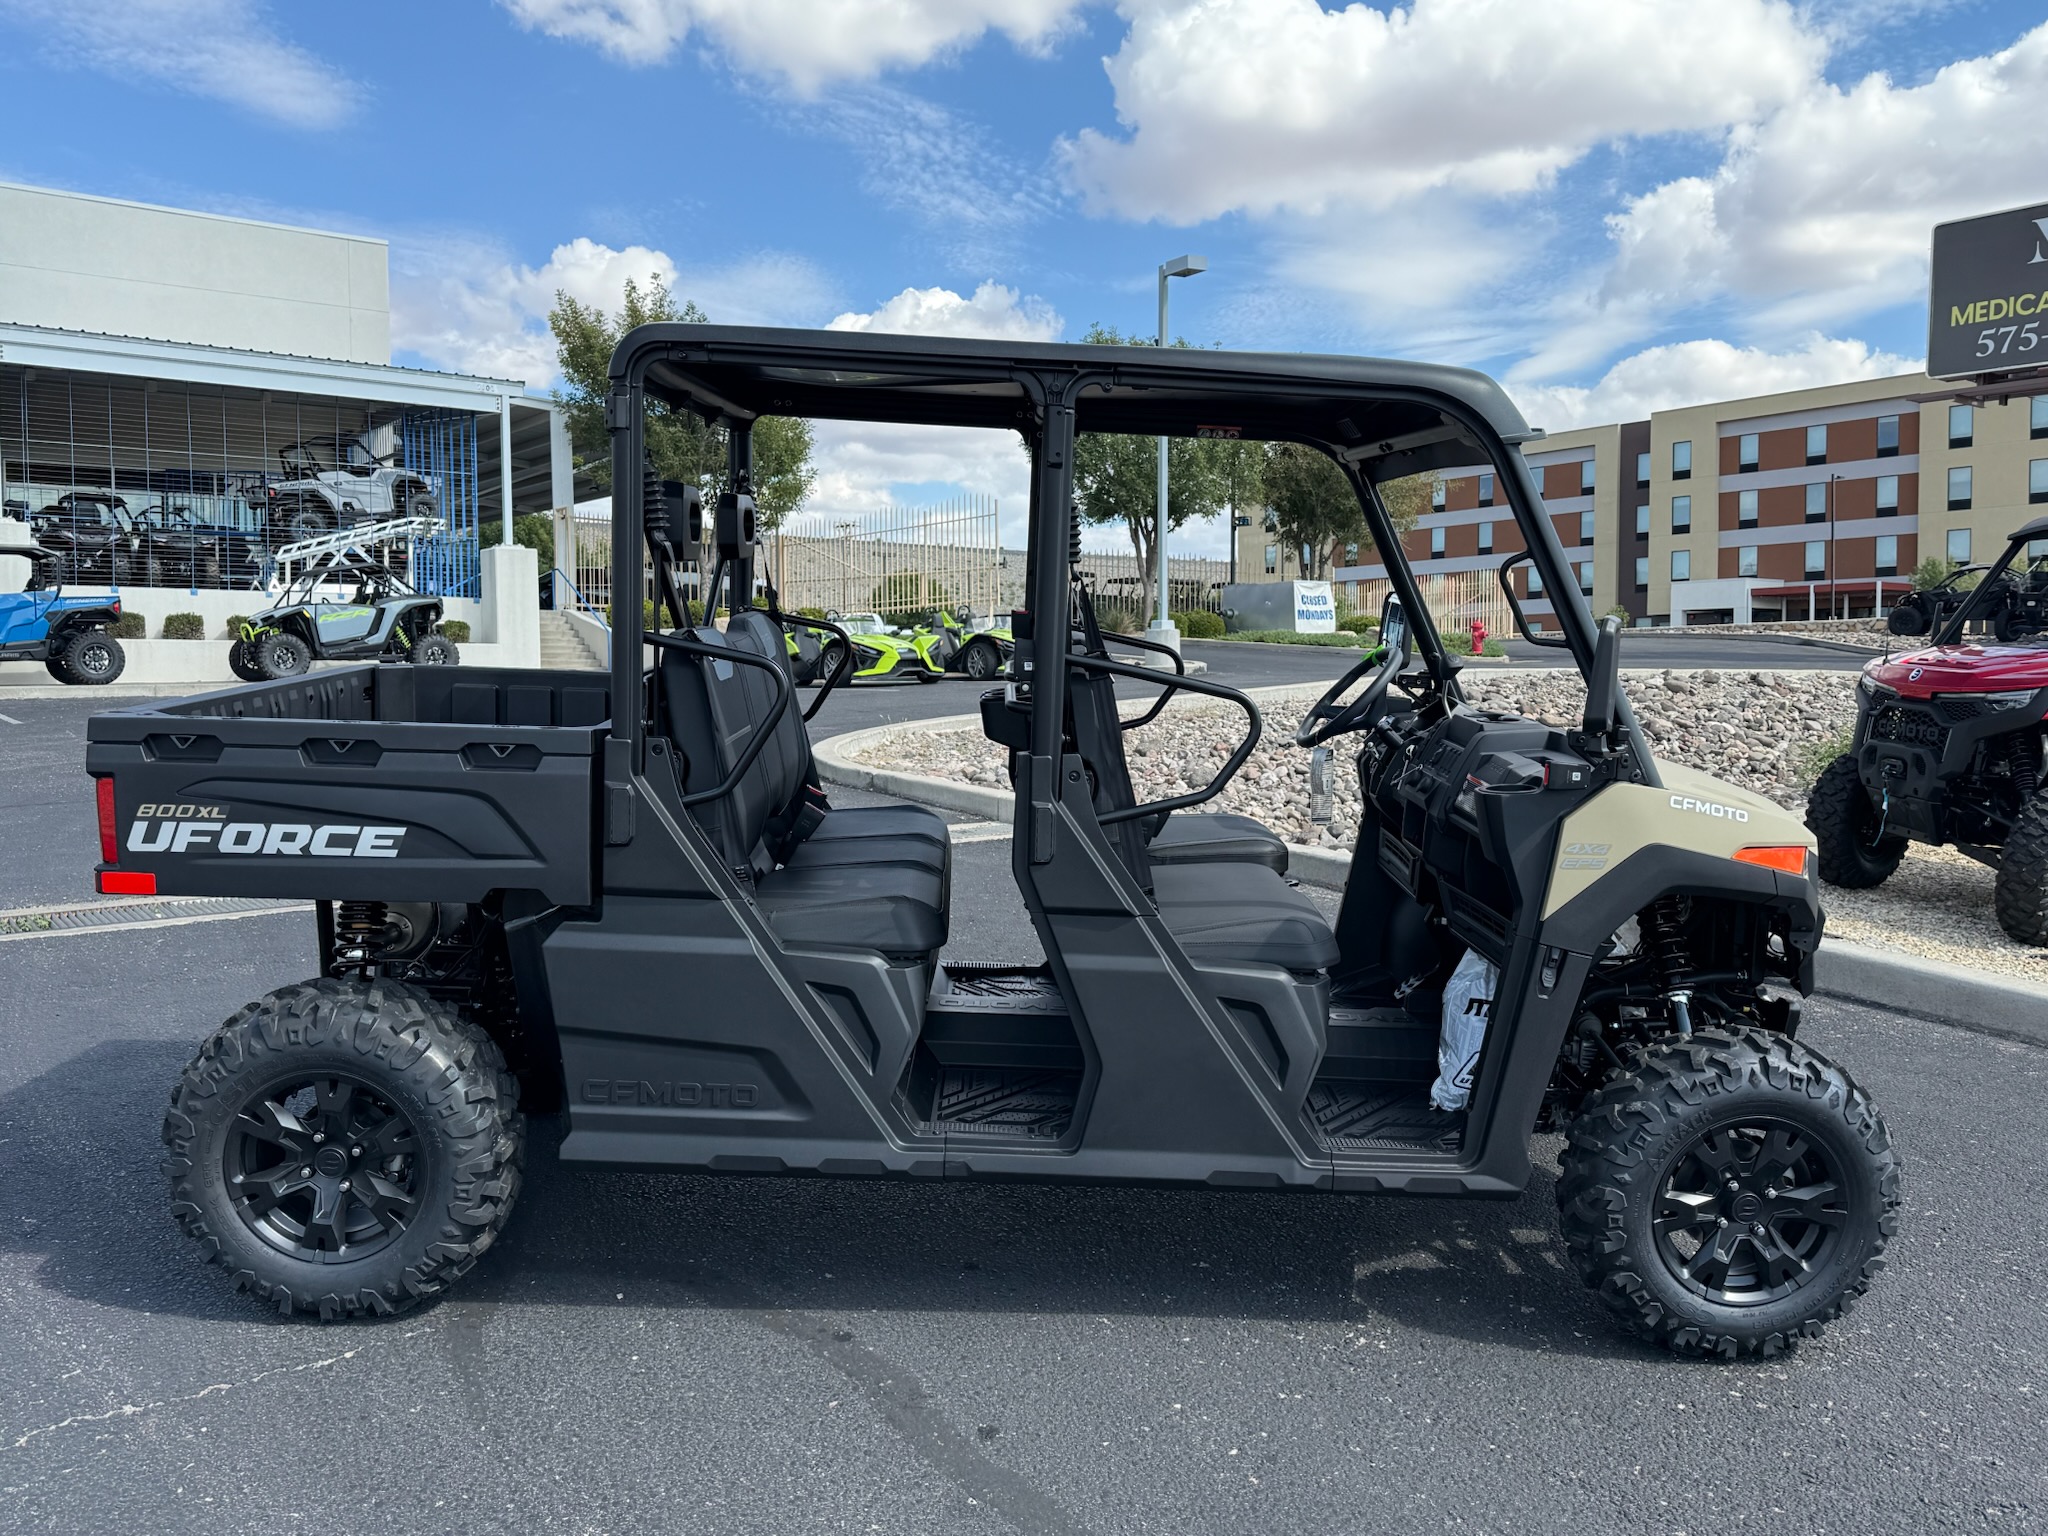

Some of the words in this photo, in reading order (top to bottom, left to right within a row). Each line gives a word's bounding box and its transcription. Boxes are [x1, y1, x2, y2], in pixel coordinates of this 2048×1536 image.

[1301, 594, 1327, 605] CLOSED
[319, 608, 371, 623] RZR
[1297, 609, 1333, 619] MONDAYS
[1879, 720, 1939, 740] CFMOTO
[1670, 795, 1749, 823] CFMOTO
[126, 821, 407, 858] UFORCE
[1564, 844, 1610, 855] 4X4
[1561, 858, 1606, 868] EPS
[582, 1078, 760, 1107] CFMOTO
